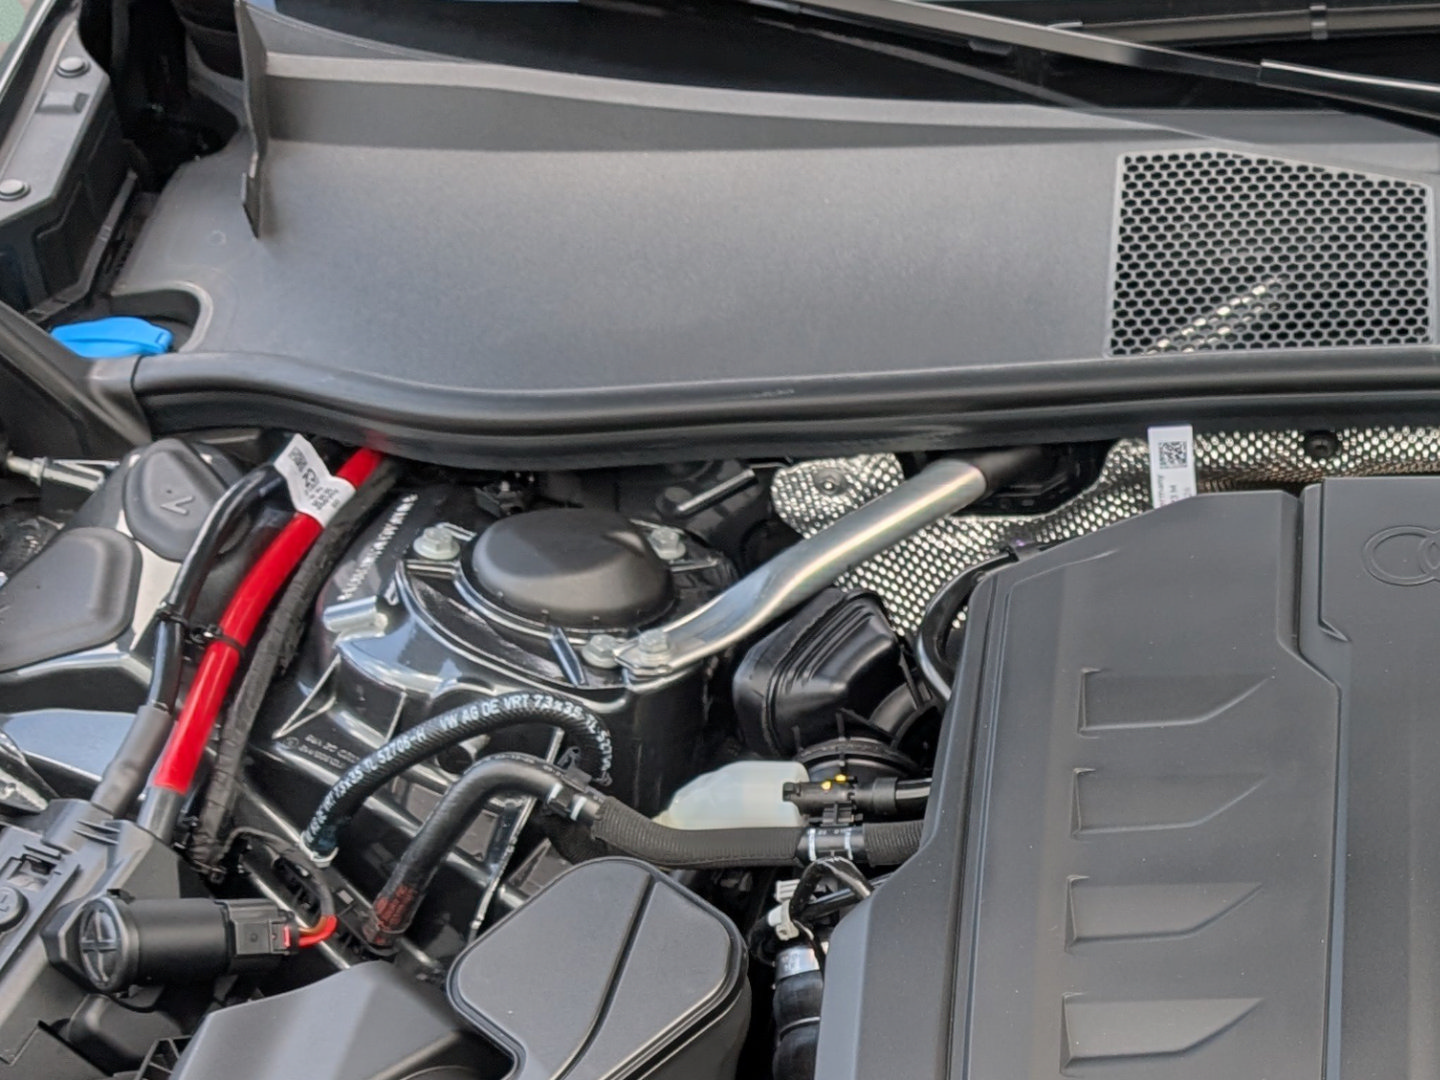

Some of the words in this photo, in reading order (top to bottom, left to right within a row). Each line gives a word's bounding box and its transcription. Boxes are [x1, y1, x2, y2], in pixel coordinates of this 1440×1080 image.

[462, 705, 479, 724] AG
[482, 698, 500, 718] DE
[503, 694, 530, 710] VRT
